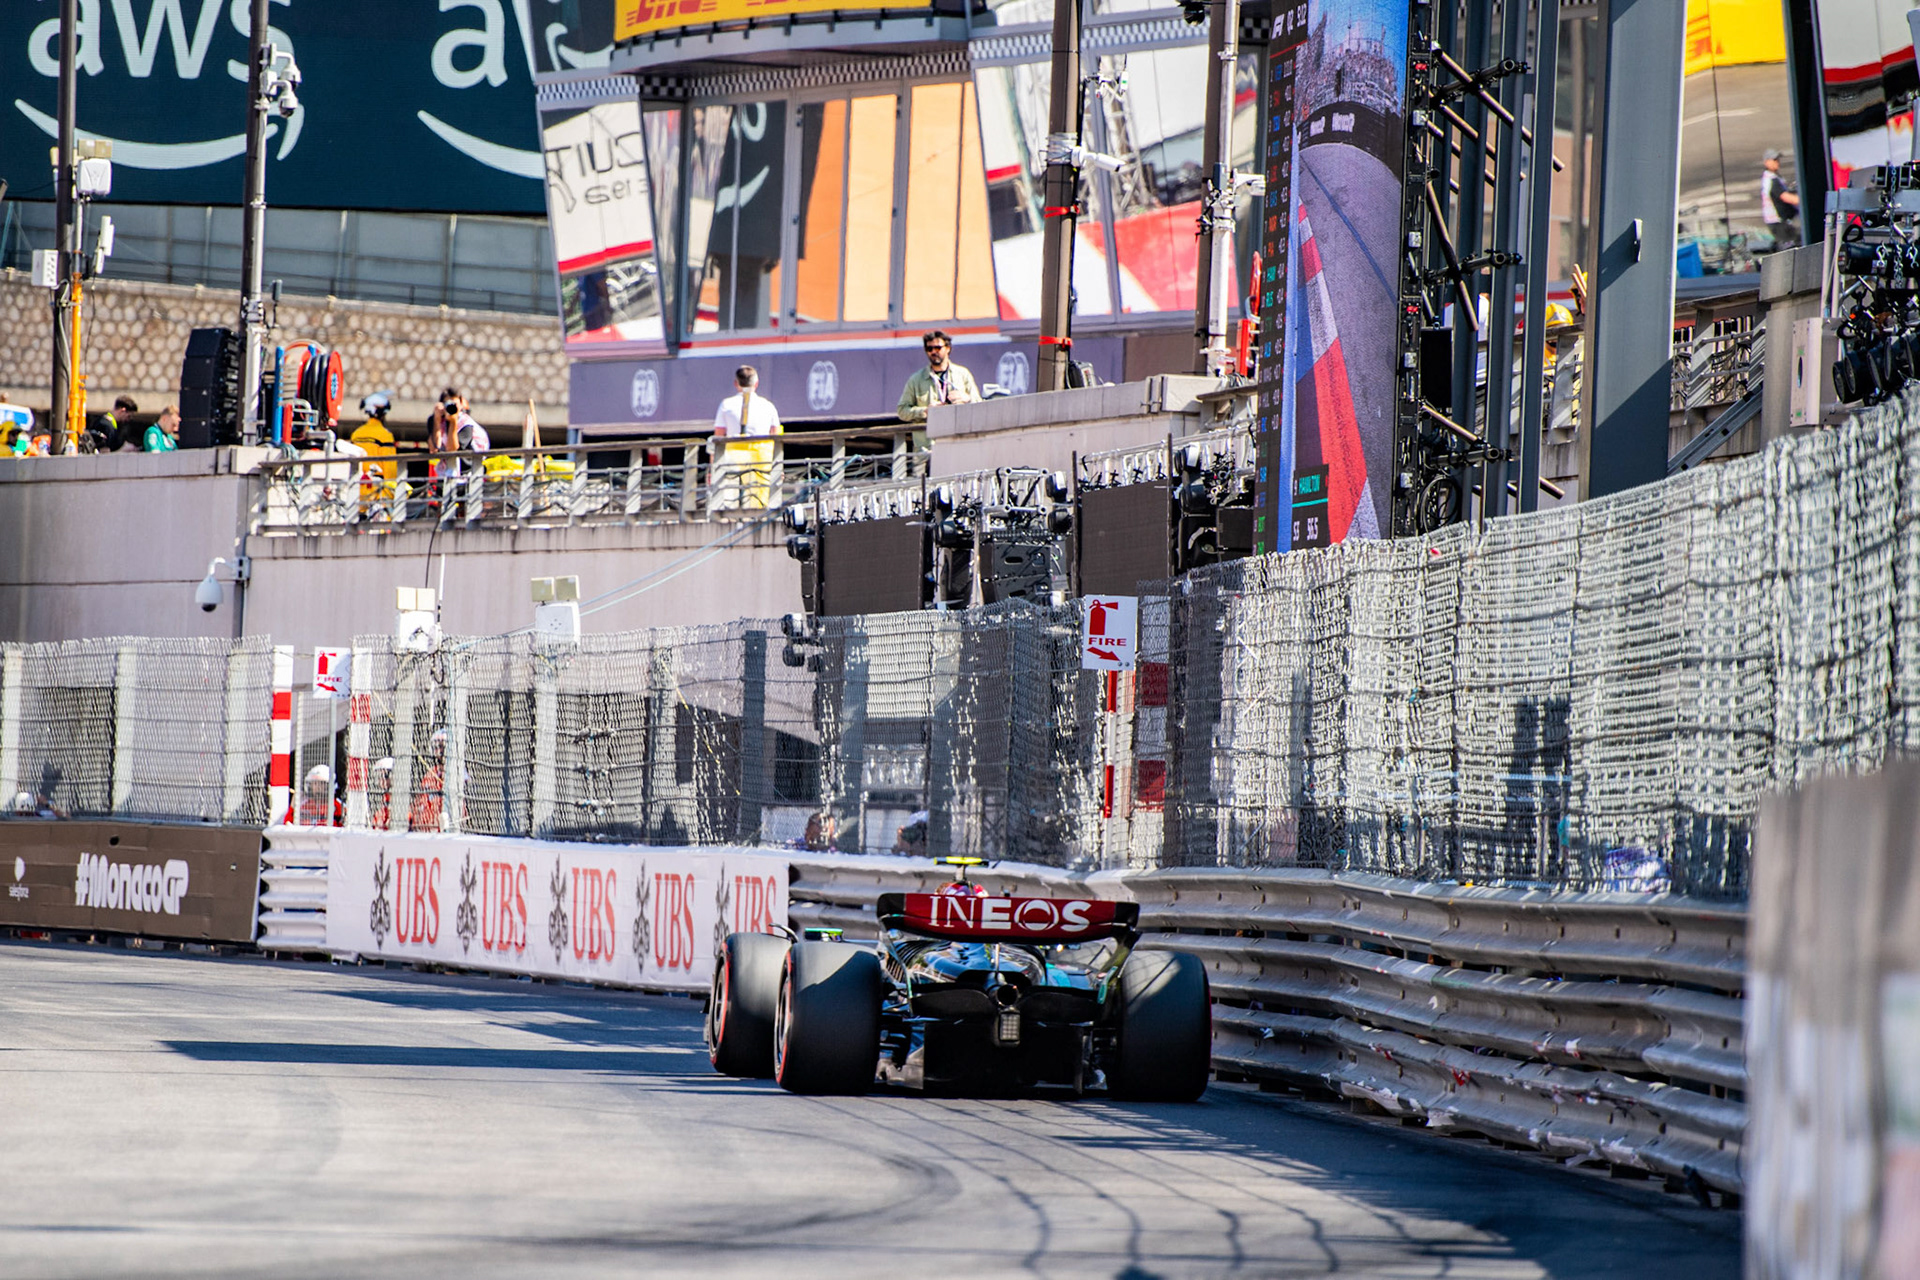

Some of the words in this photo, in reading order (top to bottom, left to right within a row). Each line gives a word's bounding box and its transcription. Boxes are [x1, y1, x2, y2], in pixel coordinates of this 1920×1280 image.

[631, 379, 657, 406] FIA
[809, 372, 836, 400] FIA
[999, 363, 1027, 395] FIA
[1088, 637, 1127, 647] FIRE
[75, 852, 190, 915] #MonacoGP
[396, 857, 442, 945] UBS
[481, 861, 528, 954] UBS
[572, 867, 618, 962] UBS
[654, 873, 695, 971] UBS
[928, 895, 1093, 933] INEOS
